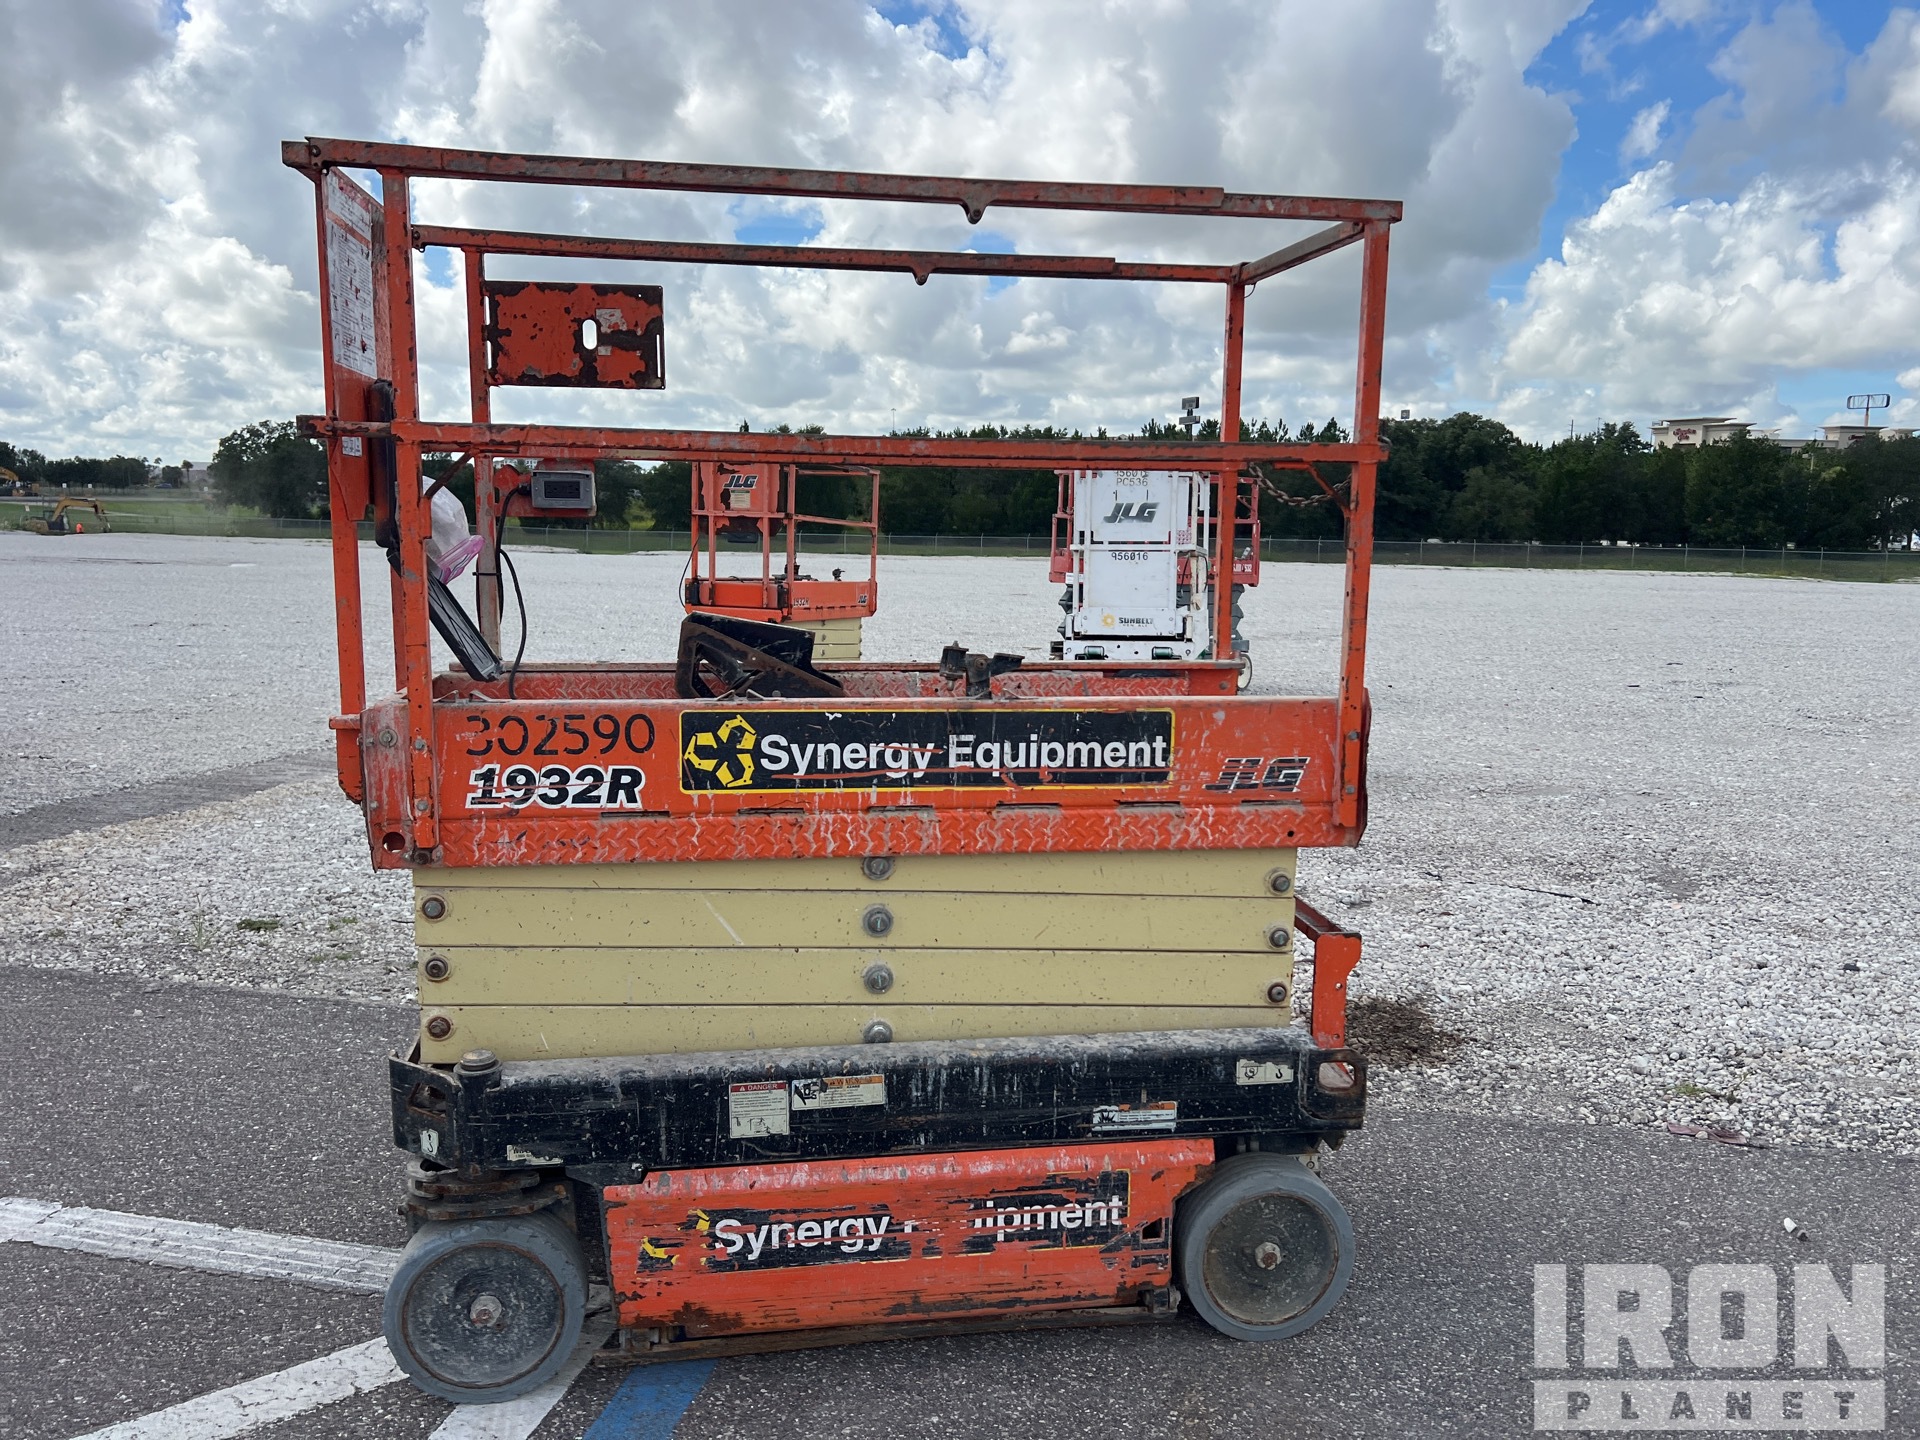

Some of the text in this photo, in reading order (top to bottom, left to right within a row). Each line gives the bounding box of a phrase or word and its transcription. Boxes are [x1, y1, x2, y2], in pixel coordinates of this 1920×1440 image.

[722, 473, 758, 489] JLG
[1116, 478, 1148, 486] PC536
[1103, 502, 1160, 523] JLG
[1111, 552, 1149, 561] 956016
[466, 713, 656, 756] 302590
[759, 733, 1168, 778] Synergy Equipment
[465, 764, 647, 810] 1932R
[1202, 756, 1311, 793] JLG
[747, 1083, 778, 1091] DANGER
[714, 1215, 891, 1261] Synergy
